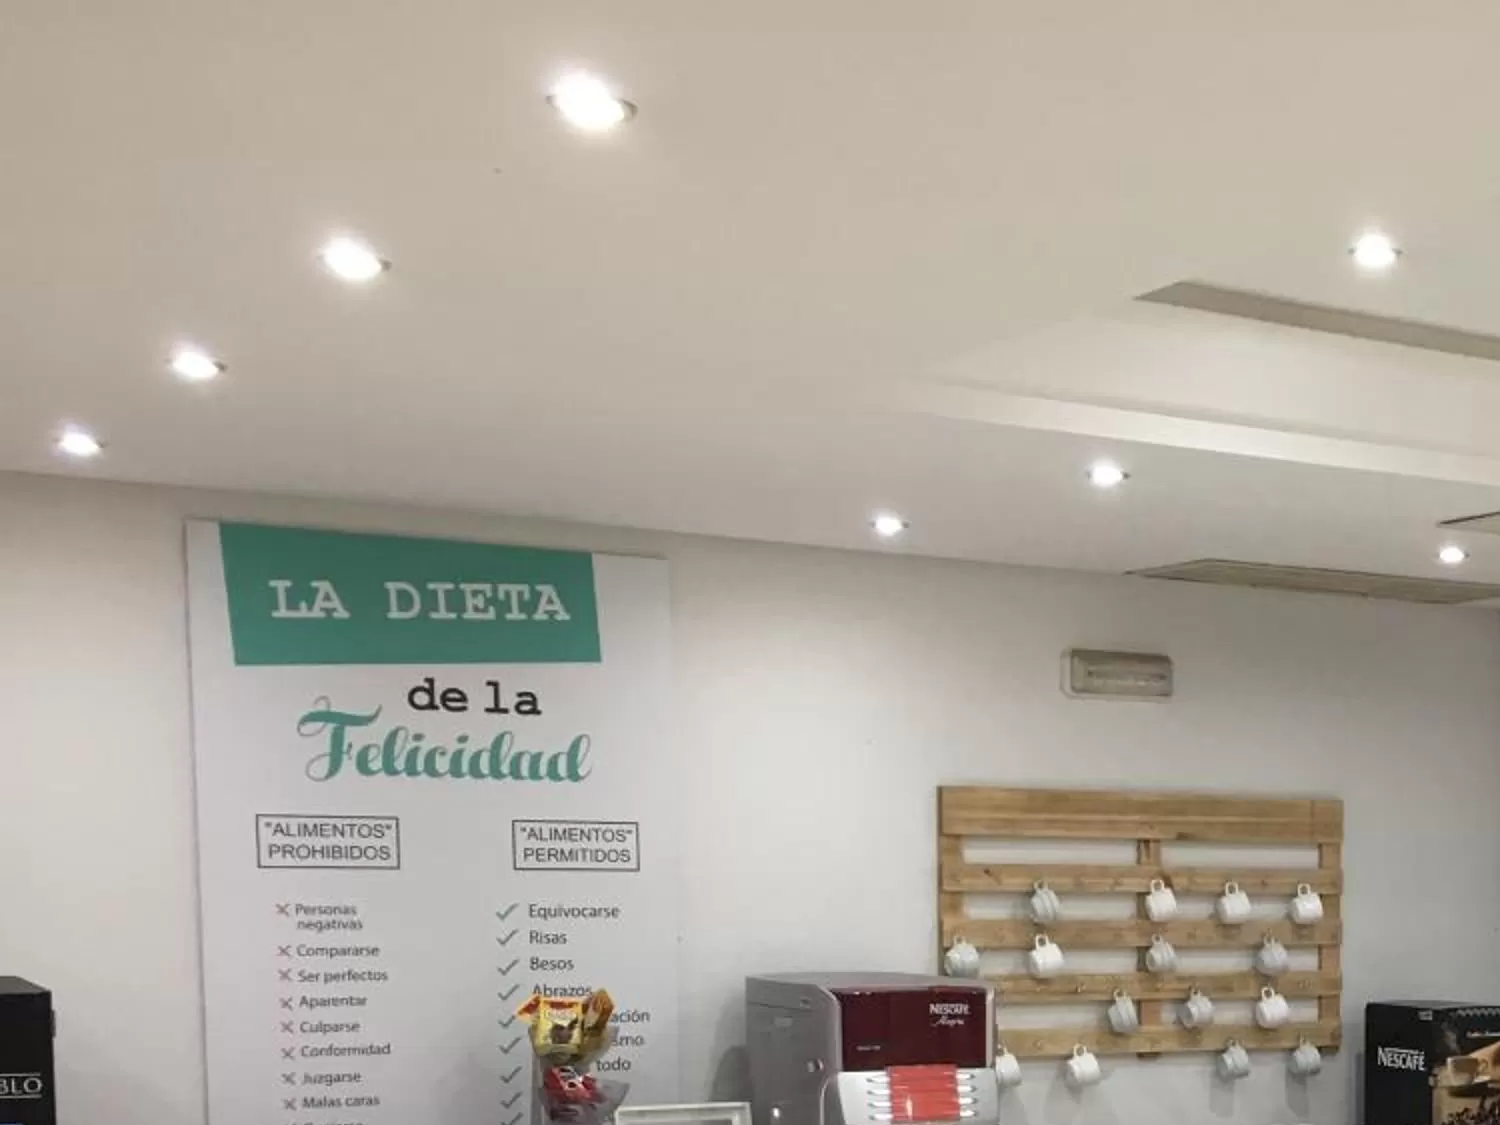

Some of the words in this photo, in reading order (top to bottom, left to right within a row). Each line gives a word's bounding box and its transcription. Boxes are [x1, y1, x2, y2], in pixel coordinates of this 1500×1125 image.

[268, 579, 350, 620] LA
[384, 580, 571, 622] DIETA
[407, 677, 469, 714] de
[484, 681, 542, 716] la
[297, 696, 592, 783] Felicidad
[268, 843, 392, 861] PROHIBIDOS
[523, 847, 632, 863] PERMITIDOS
[295, 903, 358, 916] Personas
[528, 903, 620, 920] Equivocarse
[297, 919, 363, 933] negativas
[529, 930, 568, 945] Risas
[296, 943, 381, 959] Compararse
[529, 956, 574, 972] Besos
[297, 969, 320, 983] Ser
[323, 968, 389, 985] perfectos
[532, 983, 593, 998] Abrazos
[299, 995, 368, 1010] Aparentar
[610, 1009, 650, 1023] ación
[300, 1020, 361, 1036] Culparse
[300, 1042, 391, 1057] Conformidad
[597, 1056, 631, 1072] todo
[302, 1071, 362, 1087] Juzgarse
[301, 1096, 342, 1108] Malas
[344, 1095, 380, 1107] caras
